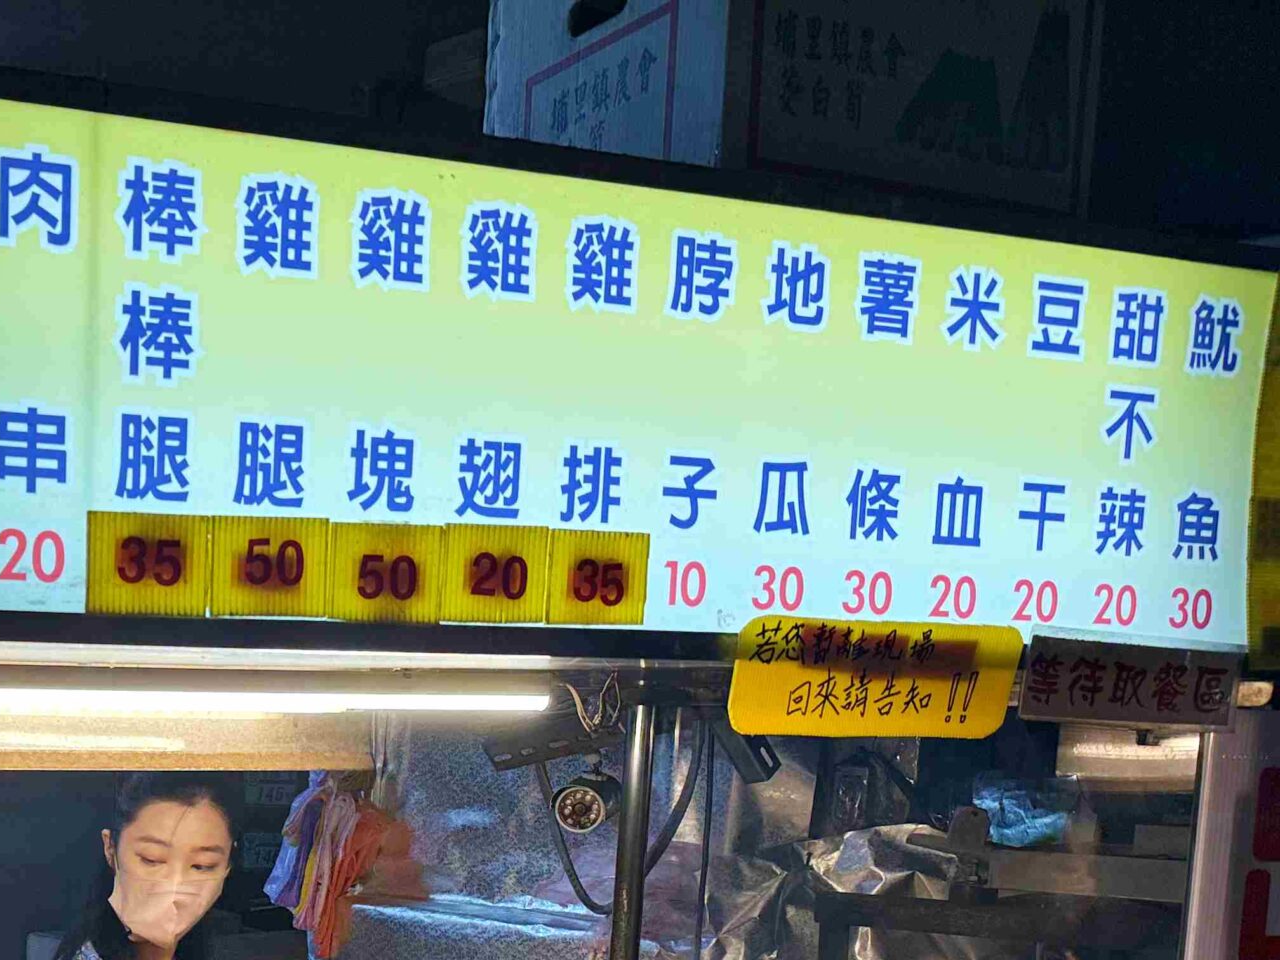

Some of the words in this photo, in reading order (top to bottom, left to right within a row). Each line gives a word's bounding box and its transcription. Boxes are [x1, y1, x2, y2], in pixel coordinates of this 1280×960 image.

[115, 165, 198, 502] 棒棒腿
[233, 181, 314, 508] 雞腿
[347, 196, 426, 513] 雞塊
[455, 208, 532, 520] 雞翅
[559, 223, 634, 523] 雞排
[662, 236, 734, 529] 脖子
[753, 247, 825, 536] 地瓜
[846, 258, 917, 542] 薯條
[932, 272, 1000, 547] 米血
[1019, 280, 1085, 551] 豆干
[1096, 292, 1164, 560] 甜不辣
[1174, 300, 1239, 560] 魷魚
[118, 535, 183, 587] 35
[244, 537, 306, 588] 50
[357, 554, 418, 601] 50
[470, 551, 530, 601] 20
[573, 558, 625, 607] 35
[664, 560, 707, 607] 10
[752, 565, 805, 612] 30
[842, 569, 893, 615] 30
[930, 575, 977, 619] 20
[1013, 579, 1059, 623] 20
[1094, 583, 1138, 626] 20
[1169, 588, 1213, 630] 30
[1027, 650, 1230, 714] 等待取餐區
